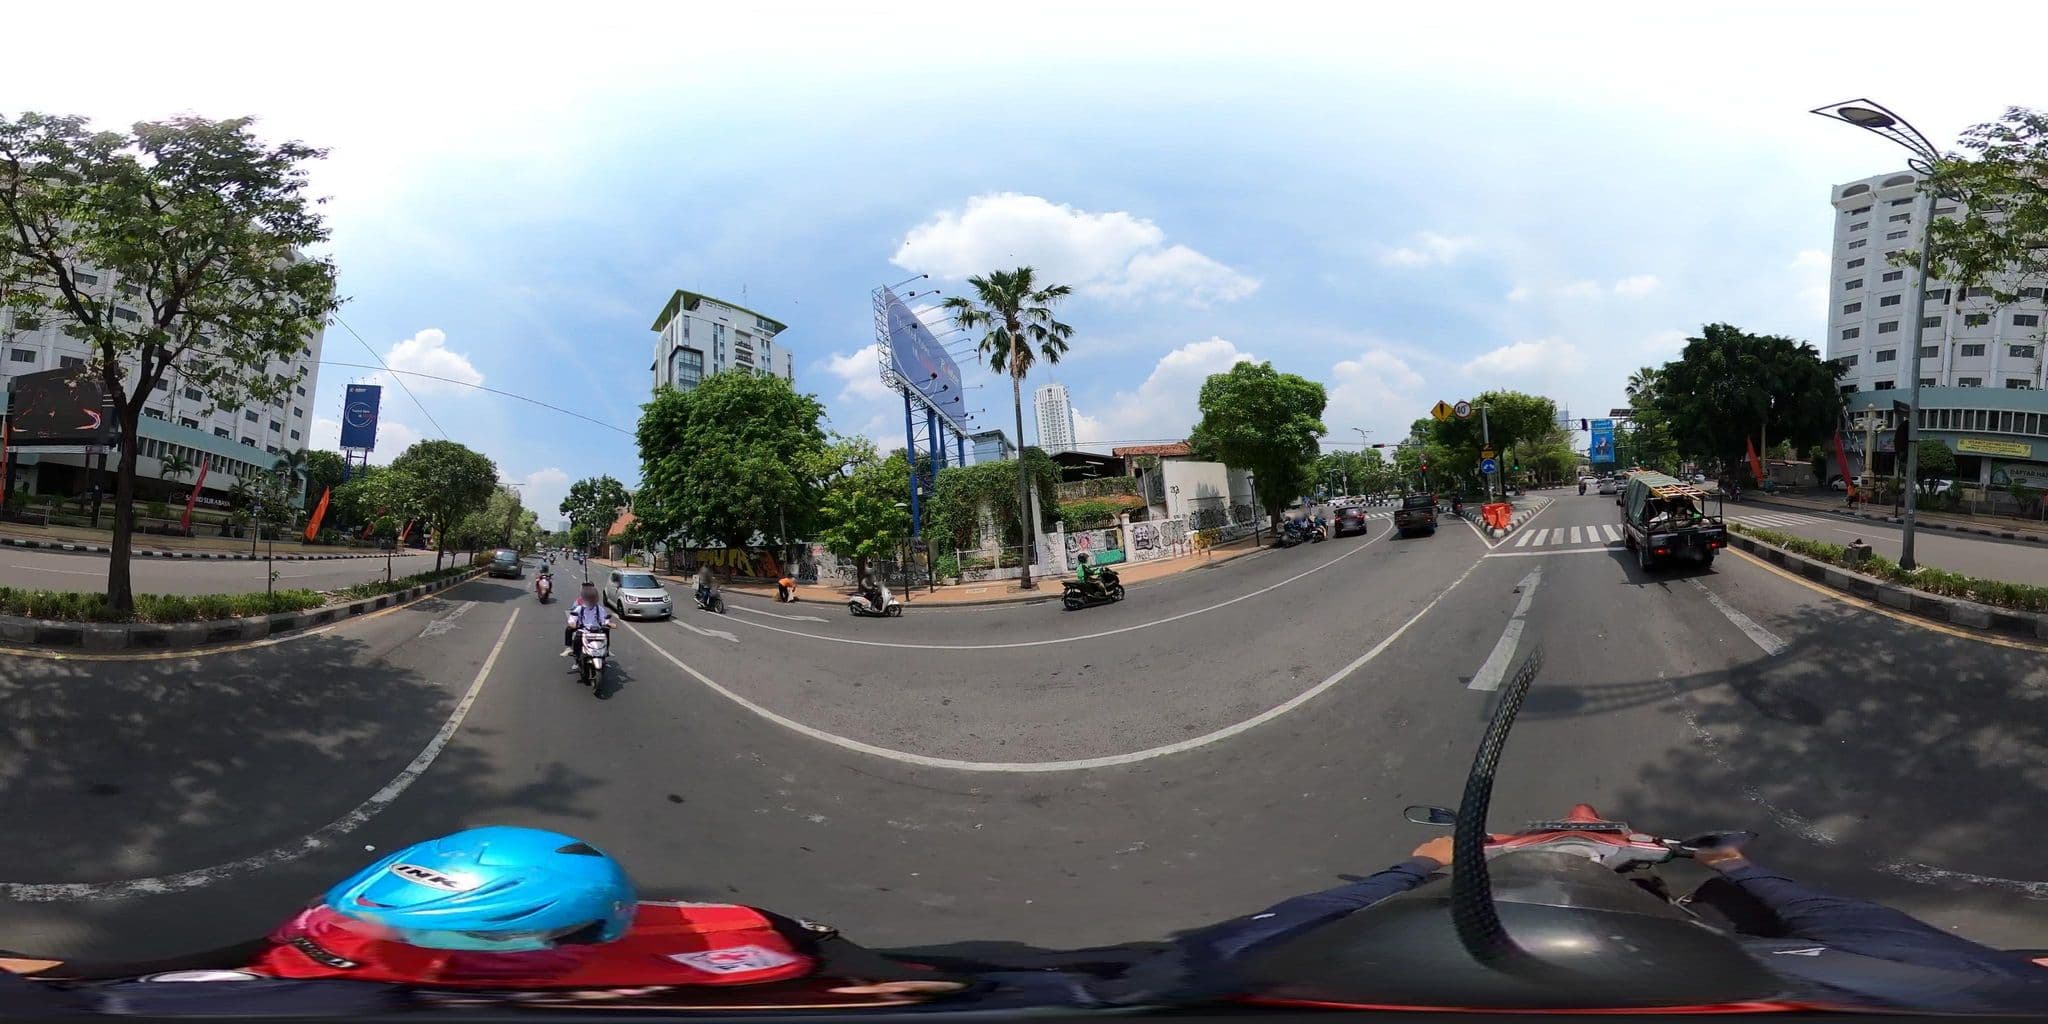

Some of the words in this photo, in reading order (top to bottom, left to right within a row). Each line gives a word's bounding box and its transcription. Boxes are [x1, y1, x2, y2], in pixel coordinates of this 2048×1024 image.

[1457, 406, 1466, 414] 40
[2010, 469, 2036, 477] DAFTAR
[203, 497, 231, 506] SURABAYA
[397, 866, 457, 888] INK
